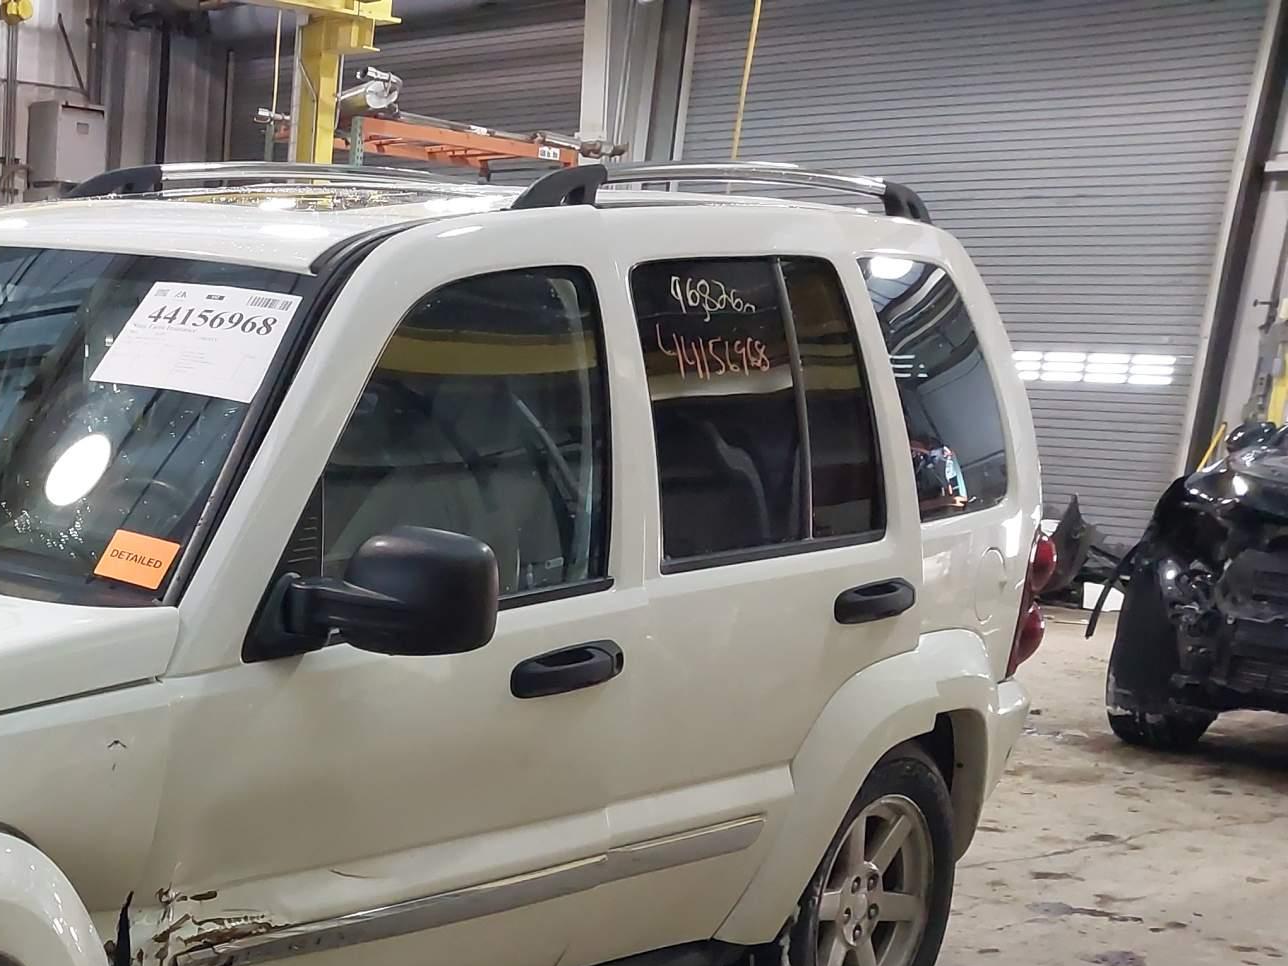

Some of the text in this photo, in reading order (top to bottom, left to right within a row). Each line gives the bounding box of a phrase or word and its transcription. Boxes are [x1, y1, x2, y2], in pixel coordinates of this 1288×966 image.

[147, 303, 278, 336] 44156968
[655, 323, 770, 380] 44156968
[109, 548, 163, 569] DETAILED
